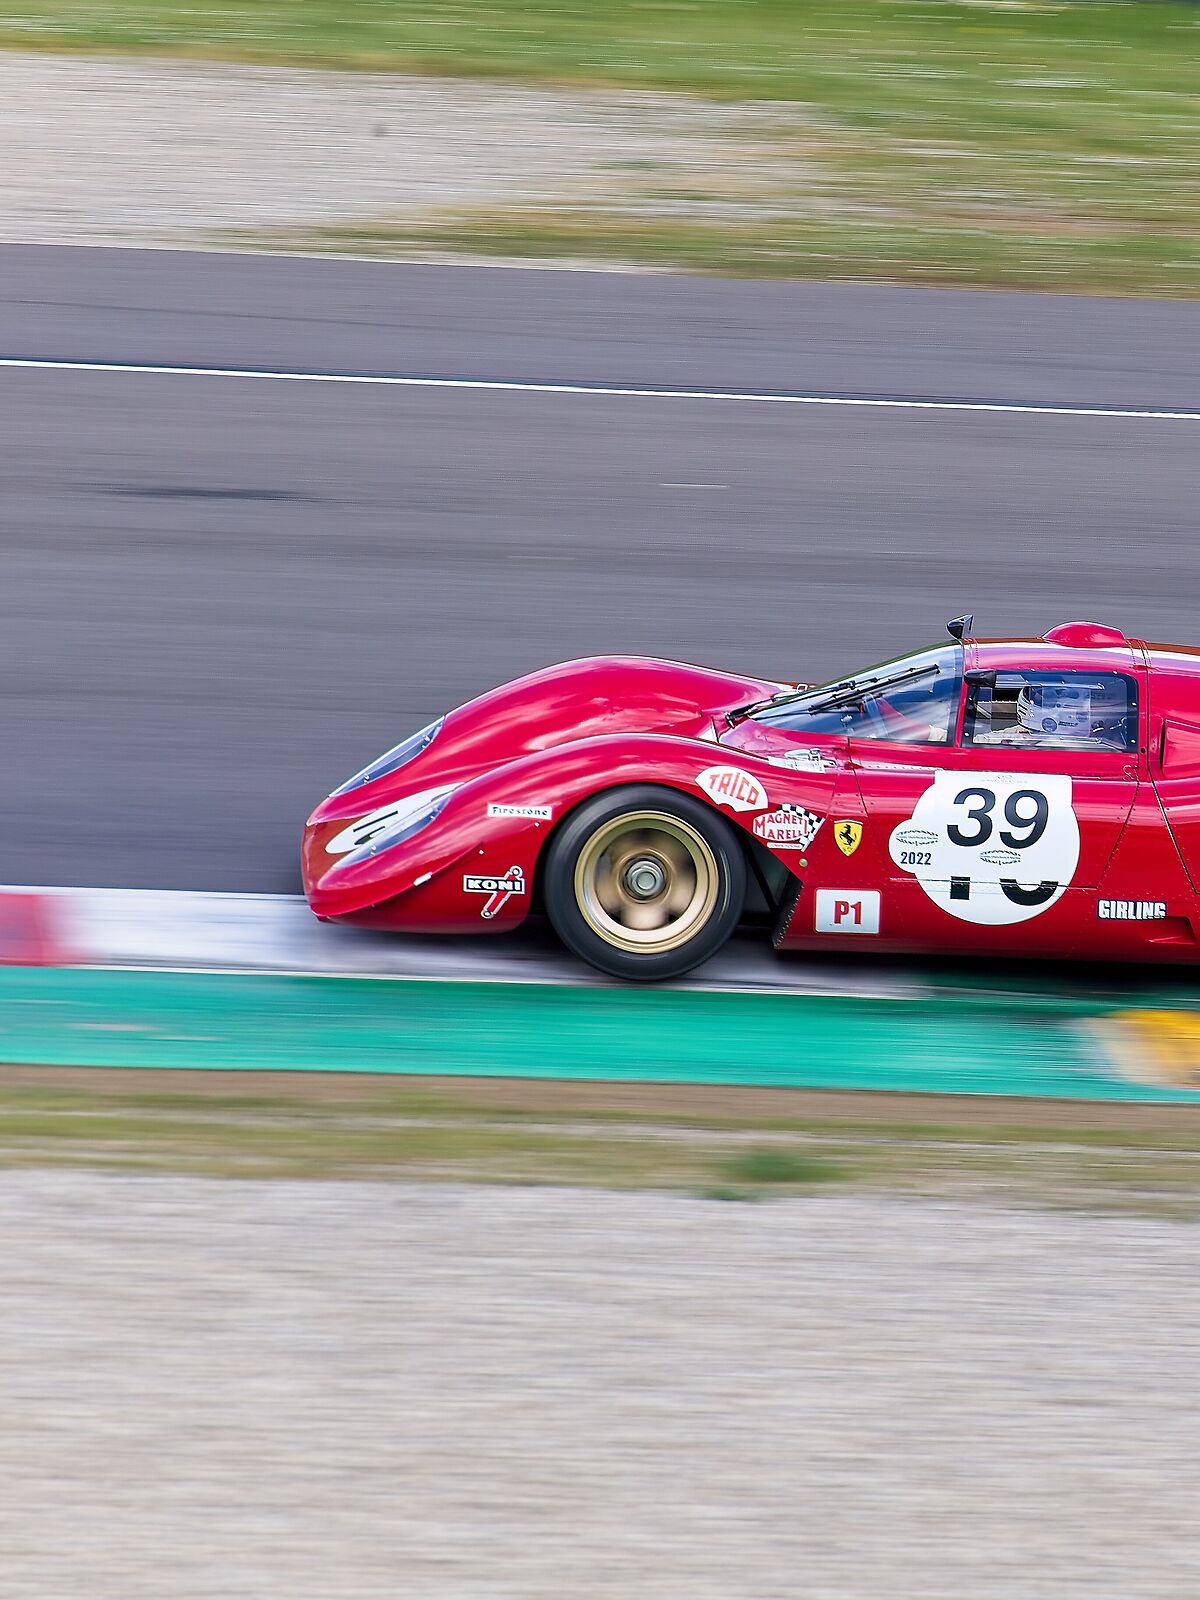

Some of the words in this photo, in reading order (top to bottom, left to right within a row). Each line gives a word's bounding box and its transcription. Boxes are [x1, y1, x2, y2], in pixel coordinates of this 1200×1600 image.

[709, 772, 760, 805] TRICO
[946, 787, 1049, 849] 39
[900, 851, 932, 866] 2022
[467, 879, 521, 891] KONI
[834, 900, 862, 925] P1
[1098, 899, 1167, 920] GIRLING
